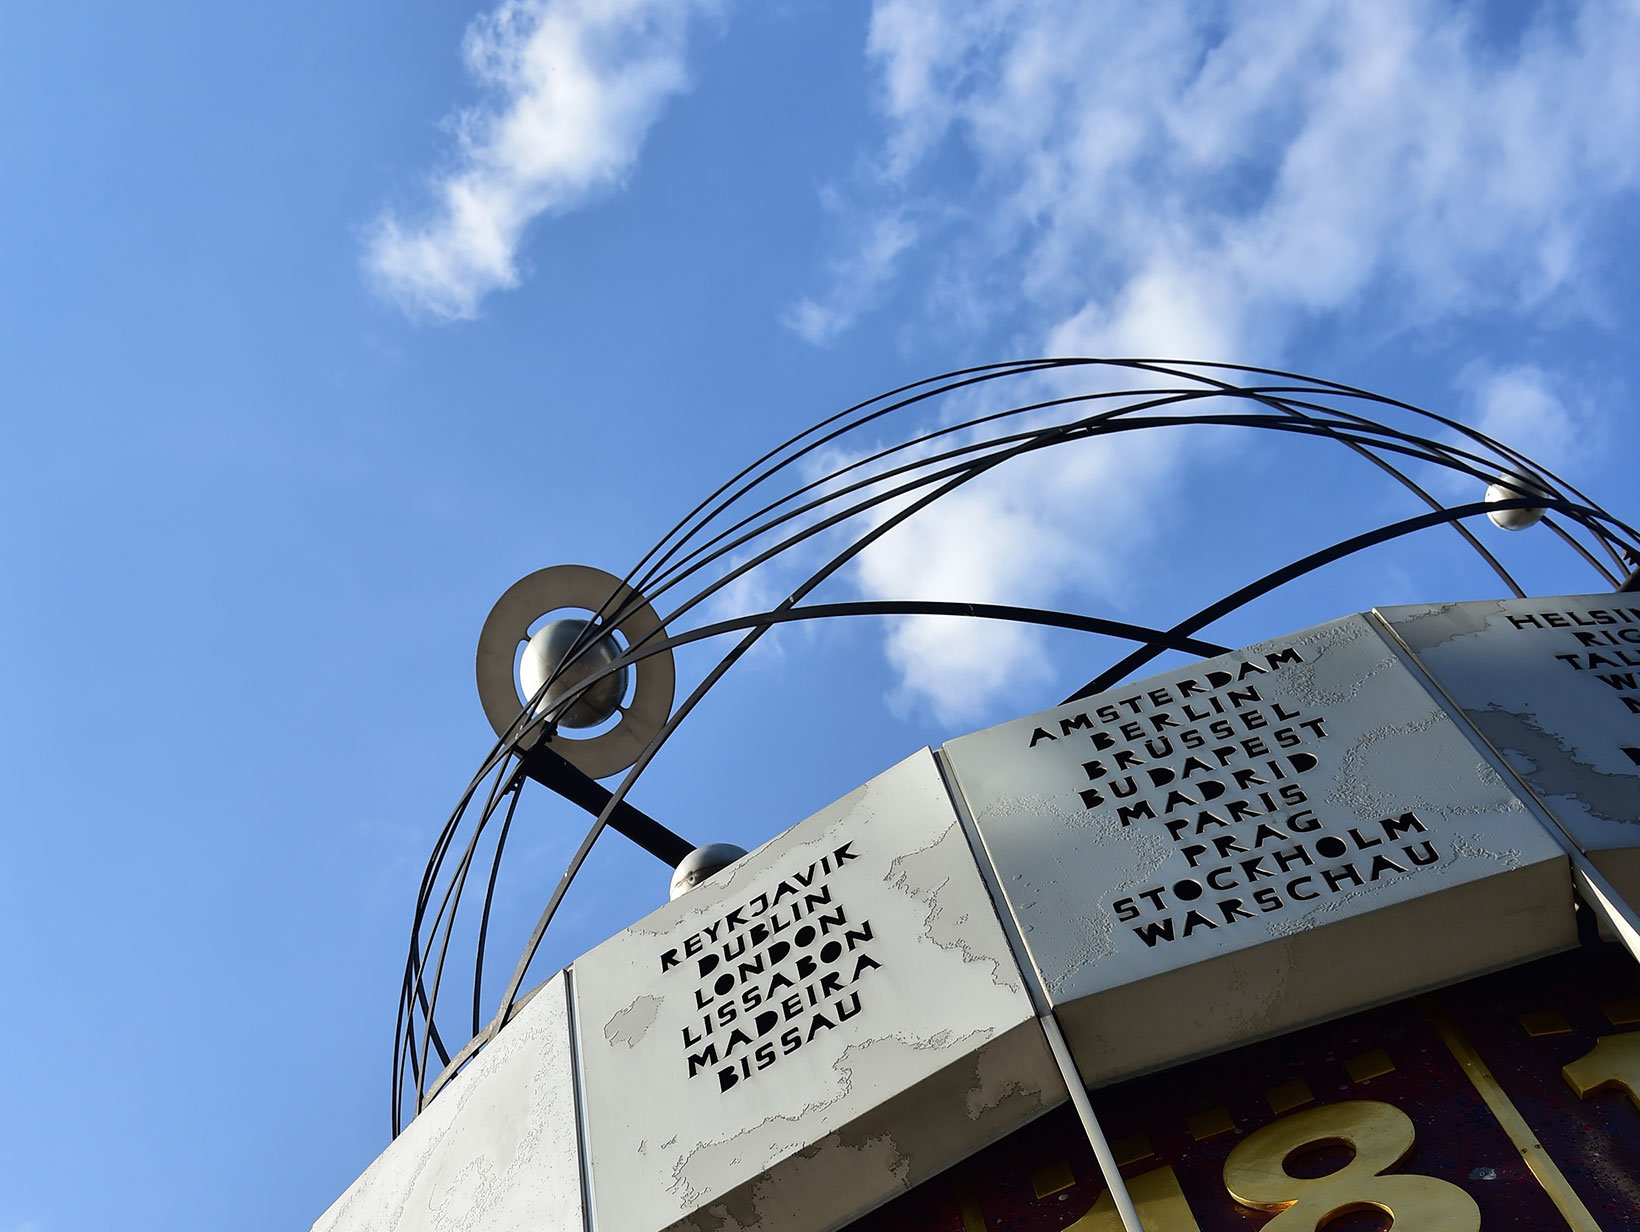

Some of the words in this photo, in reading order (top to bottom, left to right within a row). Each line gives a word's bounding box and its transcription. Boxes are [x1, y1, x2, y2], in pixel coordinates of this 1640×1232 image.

[1029, 647, 1304, 748] AMSTERDAM
[1555, 650, 1640, 670] TAL
[1078, 716, 1328, 810] BUDAPEST
[1081, 703, 1301, 781] BRÜSSEL
[1090, 685, 1263, 752] BERLIN
[1117, 753, 1318, 828] MADRID
[1164, 783, 1308, 842] PARIS
[1180, 809, 1322, 868] PRAG
[659, 840, 860, 974] REYKJAVIK
[1112, 811, 1428, 923] STOCKHOLM
[1132, 840, 1440, 948] WARSCHAU
[694, 904, 847, 1011] LONDON
[697, 884, 832, 979] DUBLIN
[681, 919, 874, 1050] LISSABON
[686, 953, 882, 1080] MADEIRA
[717, 989, 863, 1094] BISSAU
